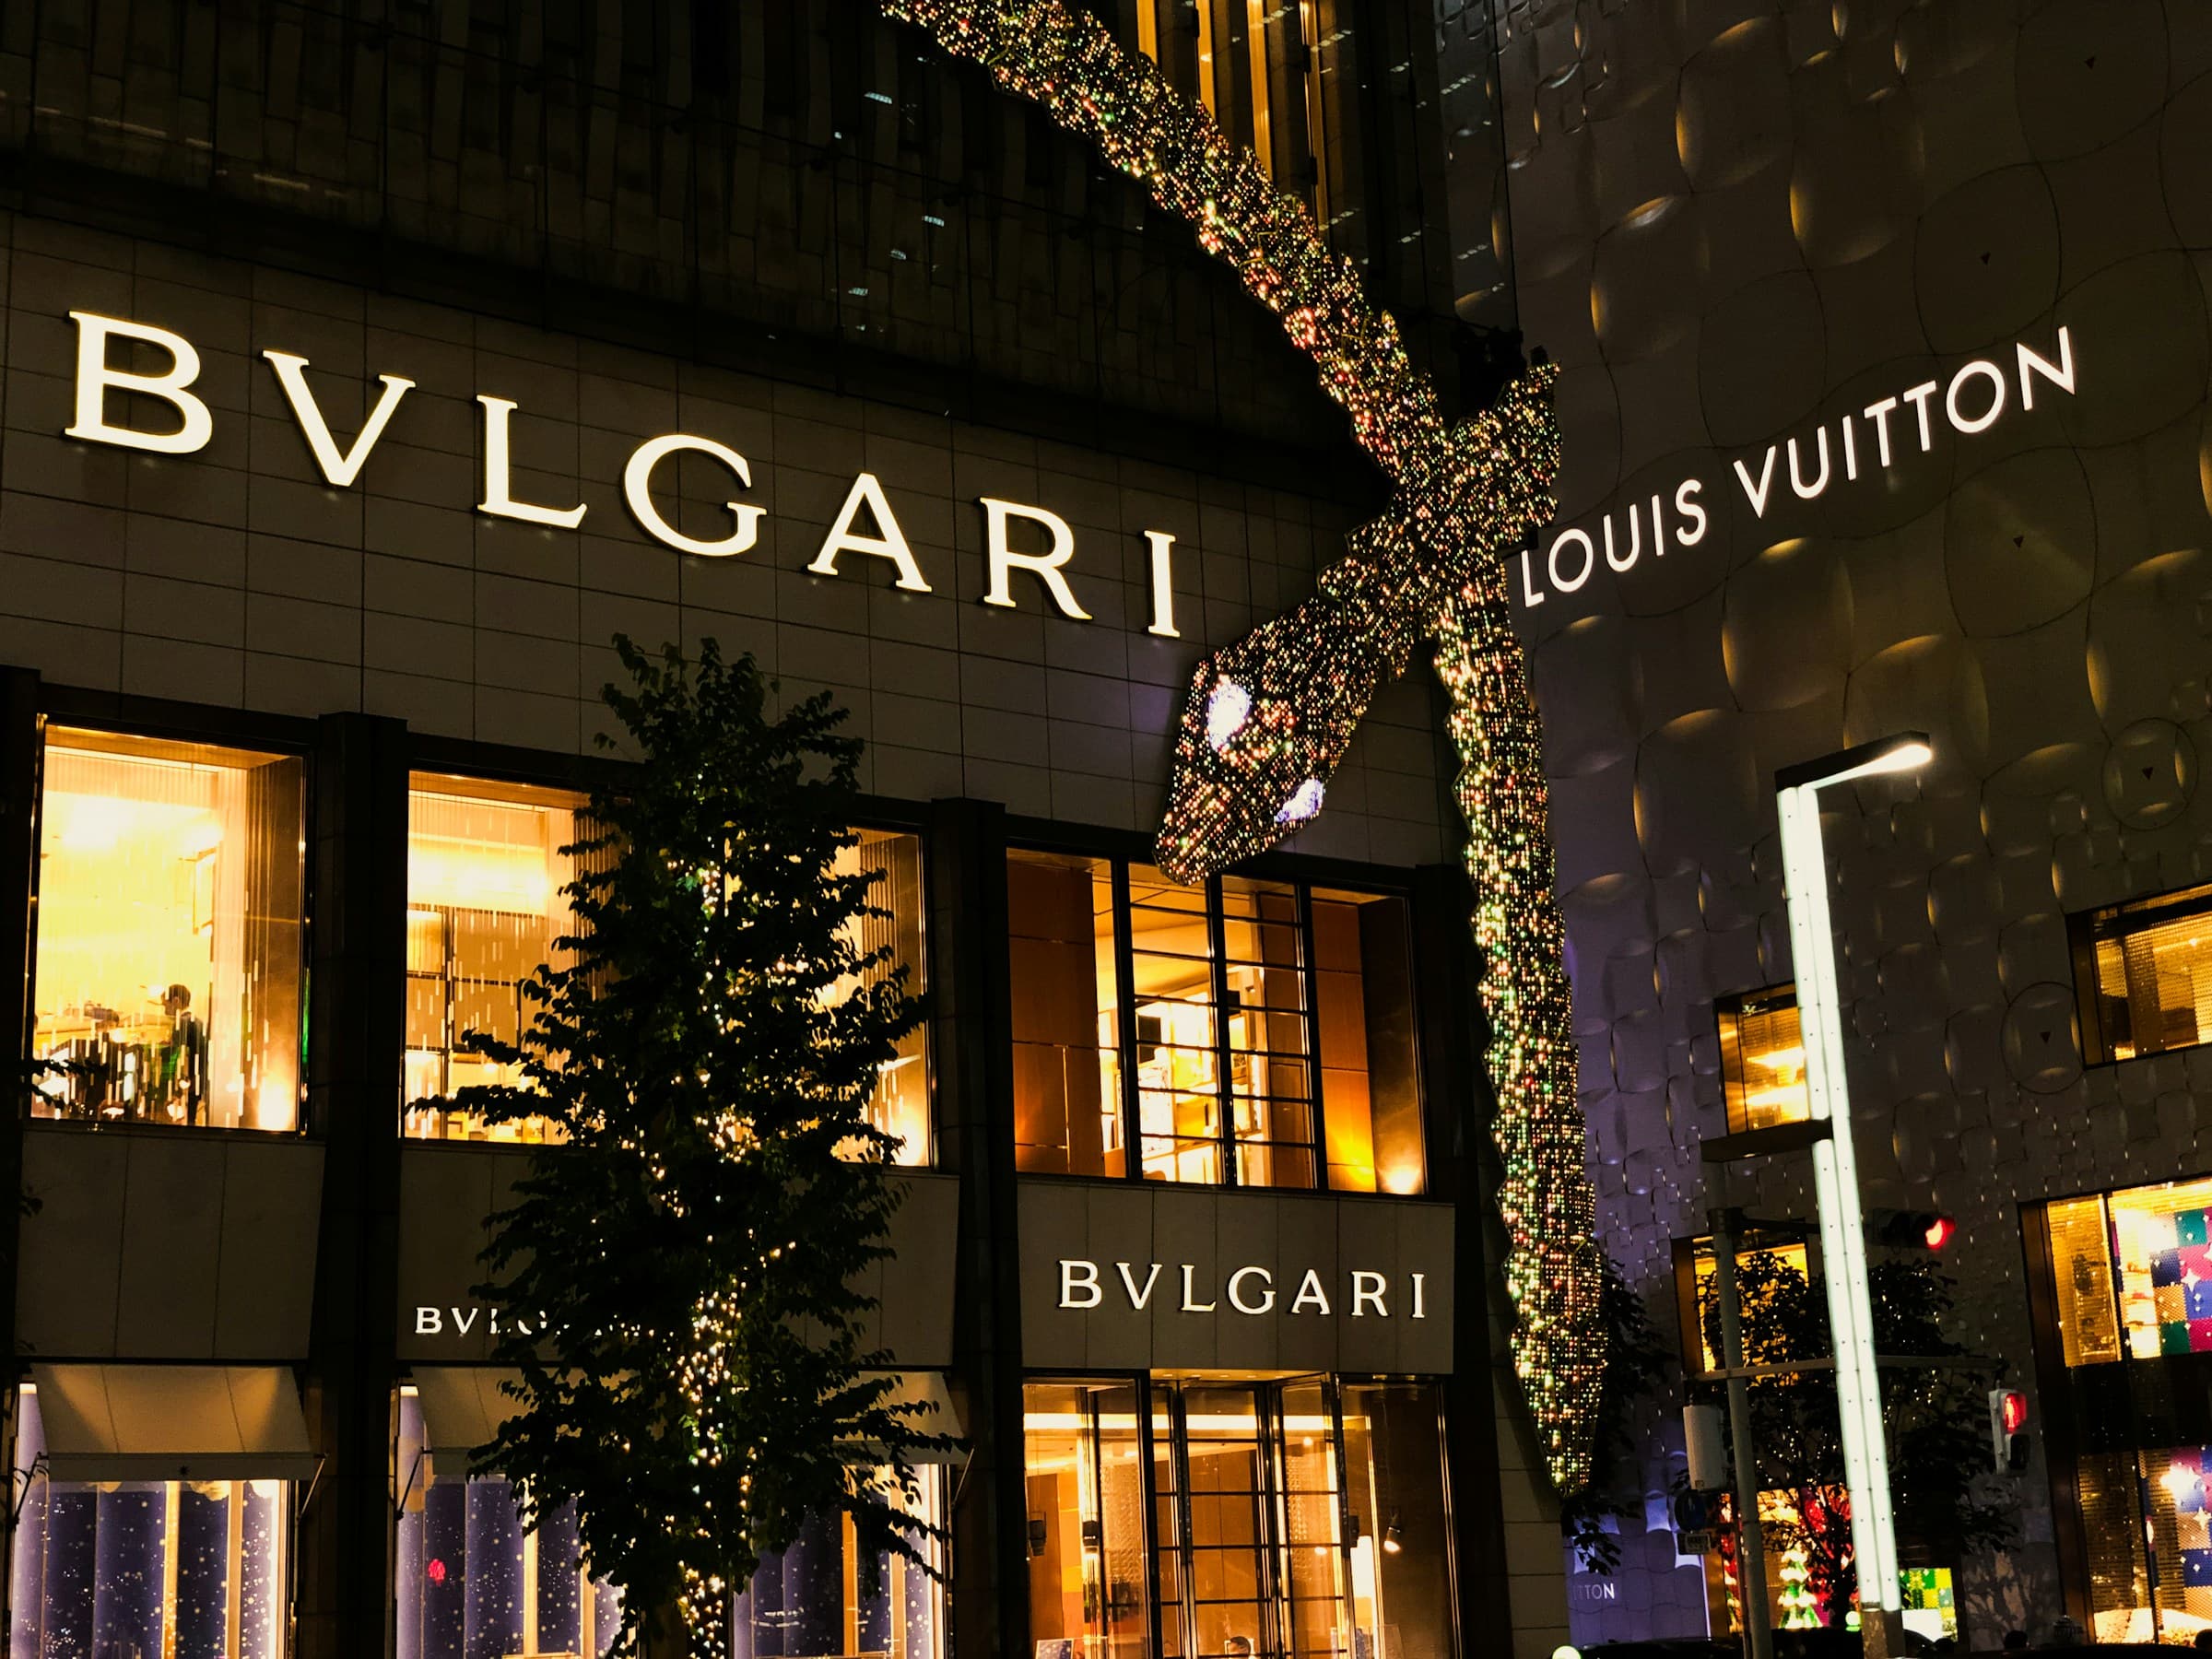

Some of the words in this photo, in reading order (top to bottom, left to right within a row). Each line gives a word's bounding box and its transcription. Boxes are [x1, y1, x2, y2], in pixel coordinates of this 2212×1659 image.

[65, 311, 1181, 638] BVLGARI
[1521, 478, 1708, 608] LOUIS
[1733, 325, 2076, 519] VUITTON
[1058, 1260, 1425, 1319] BVLGARI
